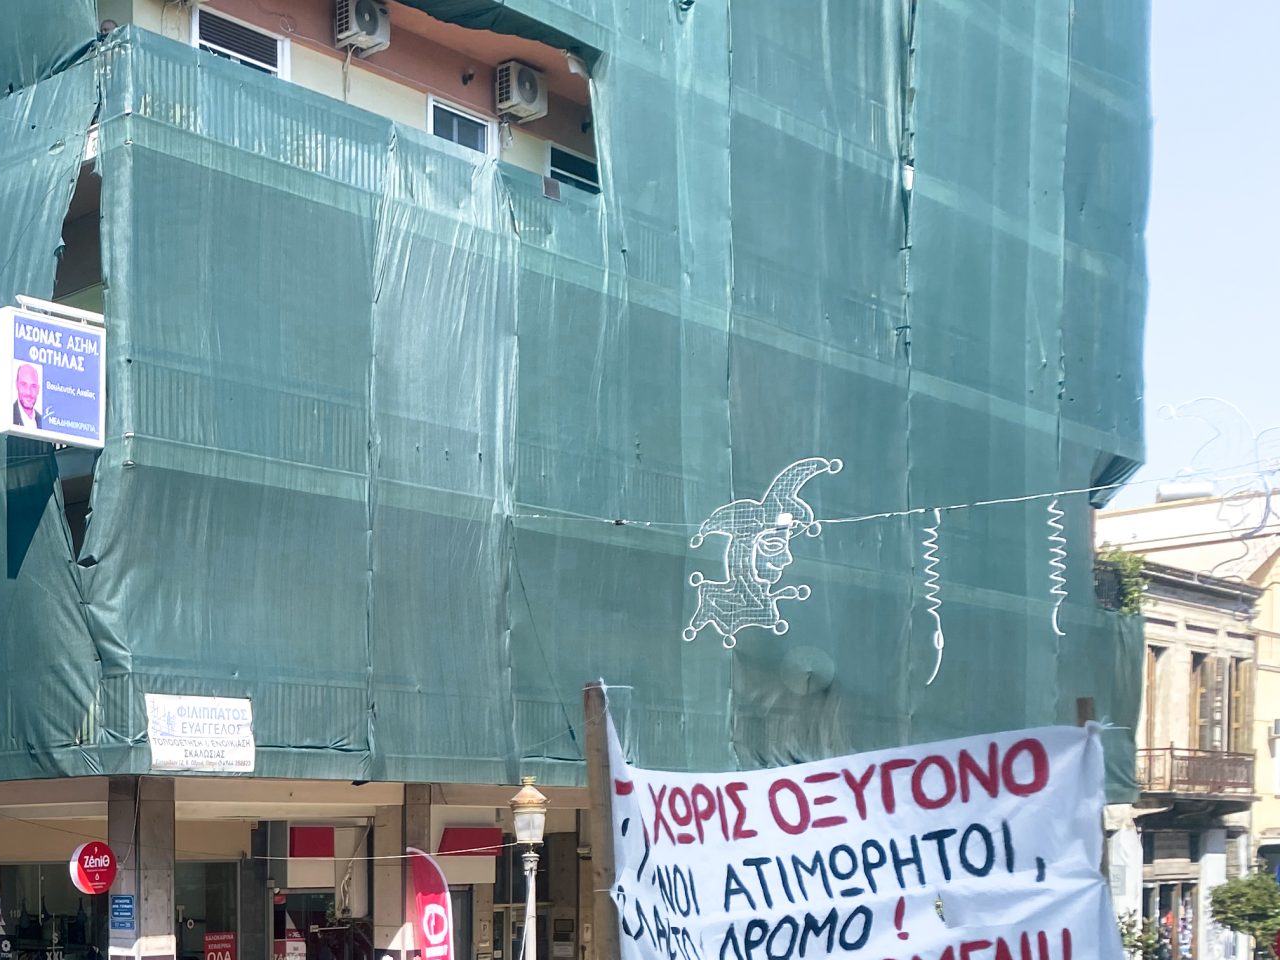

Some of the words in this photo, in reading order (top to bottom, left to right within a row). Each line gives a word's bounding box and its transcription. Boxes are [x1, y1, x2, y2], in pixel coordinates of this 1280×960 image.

[15, 322, 62, 347] ΙΑΣΟΝΑΣ
[28, 346, 85, 371] ΦΩΤΗΛΑΣ
[176, 705, 248, 720] ΦΙΛΙΠΠΑΤΟΣ
[181, 721, 242, 735] ΕΥΑΓΓΕΛΟΣ
[768, 737, 1051, 837] ΟΞΥΓΟΝΟ
